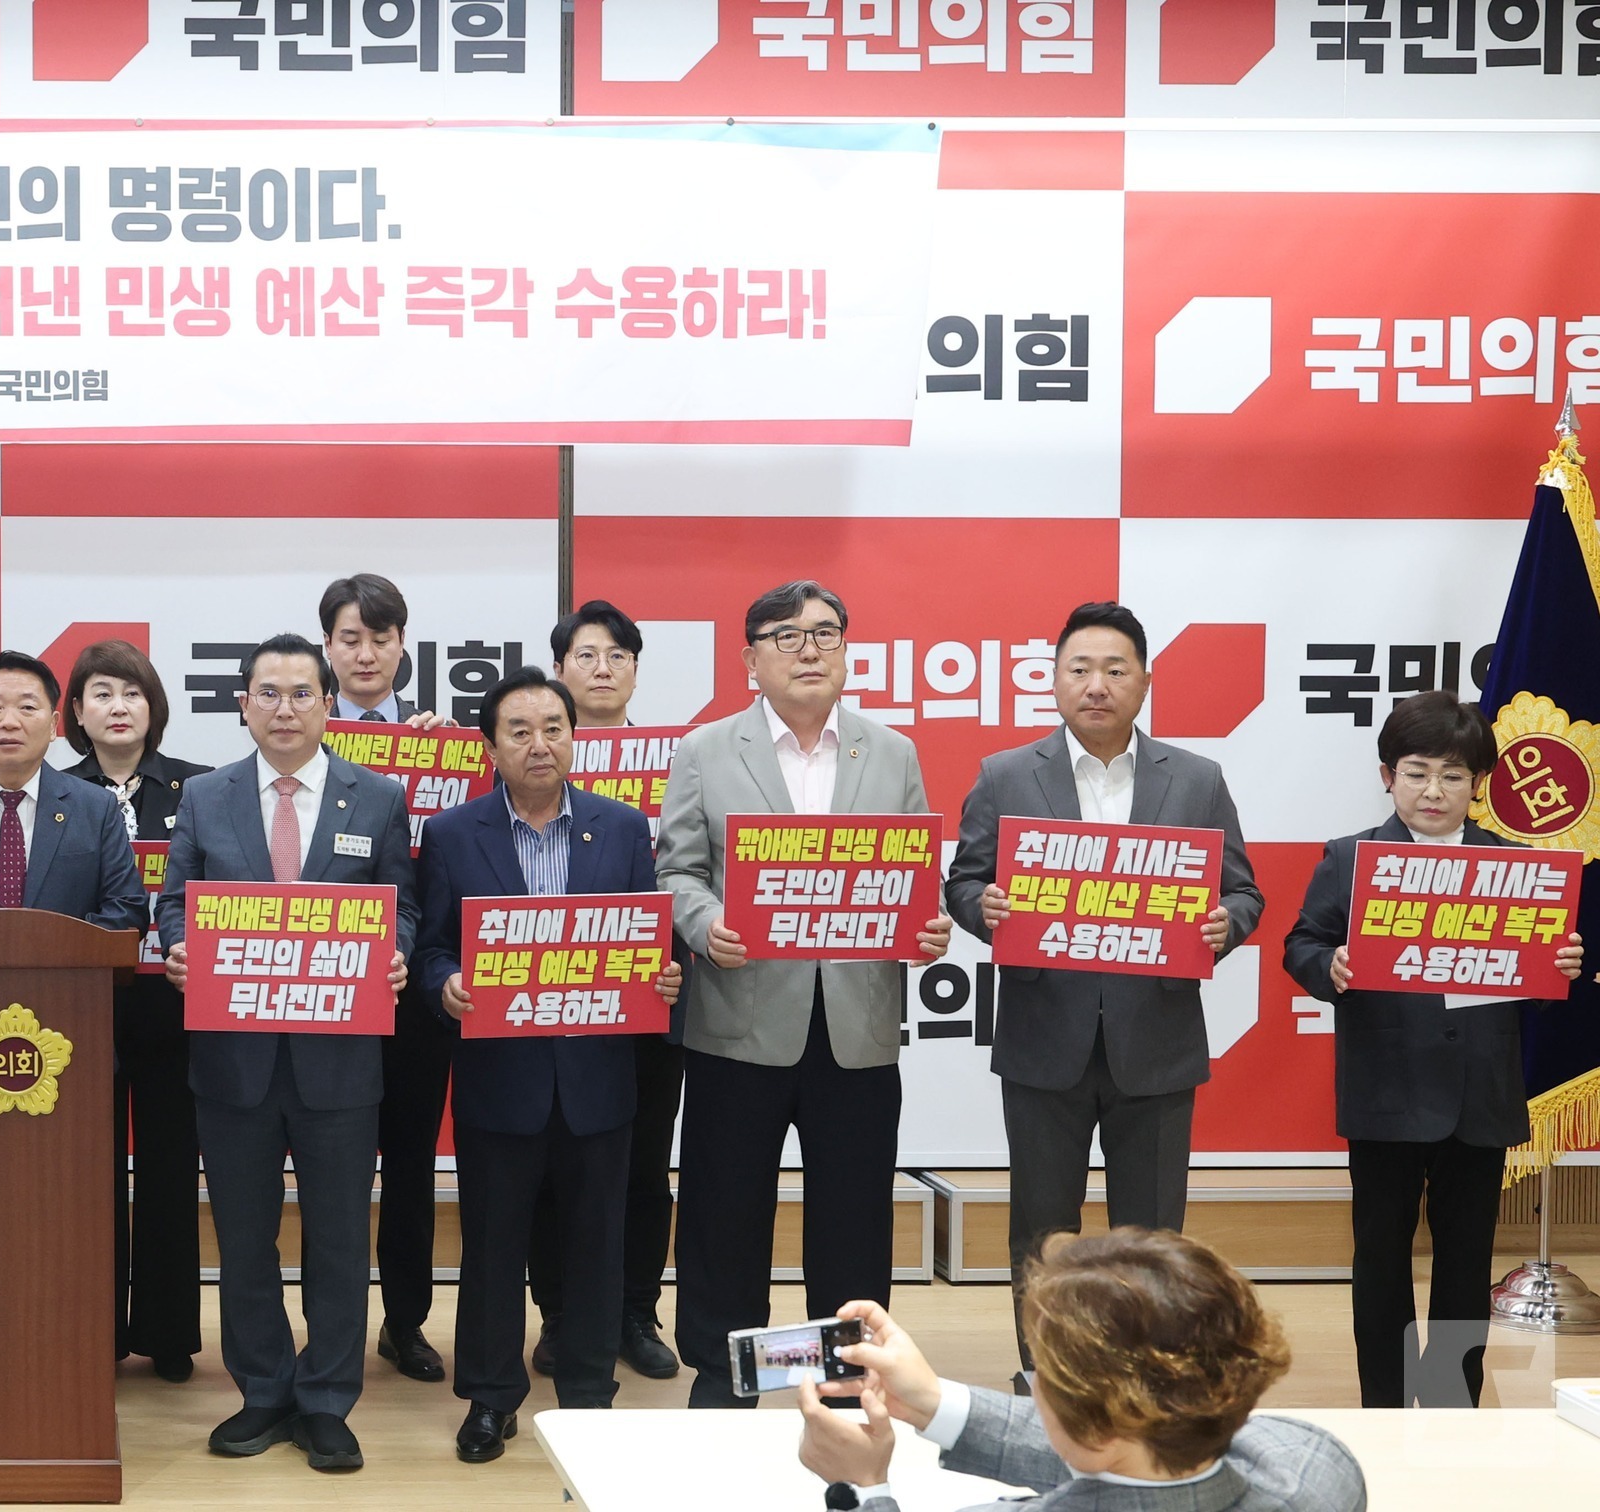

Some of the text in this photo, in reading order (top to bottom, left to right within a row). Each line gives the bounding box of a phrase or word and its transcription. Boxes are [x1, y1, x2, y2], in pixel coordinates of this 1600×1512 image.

[184, 0, 526, 73] 국민의힘
[752, 0, 1094, 74] 국민의힘
[108, 166, 402, 243] 명령이다.
[105, 265, 232, 338] 민생
[255, 266, 385, 338] 예산
[404, 266, 535, 338] 즉각
[554, 266, 828, 340] 수용하라!
[395, 736, 439, 769] 민생
[440, 739, 487, 778] 예산,
[1504, 745, 1575, 829] 의회
[735, 828, 933, 868] 깎아버린 민생 예산,
[1013, 830, 1208, 880] 추미애 지사는
[753, 869, 915, 906] 도민의 삶이
[1008, 875, 1211, 923] 민생 예산 복구
[1370, 854, 1568, 900] 추미애 지사는
[195, 895, 284, 932] 깎아버린
[286, 897, 334, 933] 민생
[337, 898, 388, 941] 예산,
[477, 906, 660, 945] 추미애 지사는
[768, 912, 899, 949] 무너진다!
[1360, 899, 1569, 944] 민생 예산 복구
[213, 938, 371, 979] 도민의 삶이
[1038, 921, 1168, 966] 수용하라.
[1392, 944, 1524, 987] 수용하라.
[472, 947, 663, 987] 민생 예산 복구
[227, 982, 356, 1022] 무너진다!
[505, 989, 627, 1027] 수용하라.
